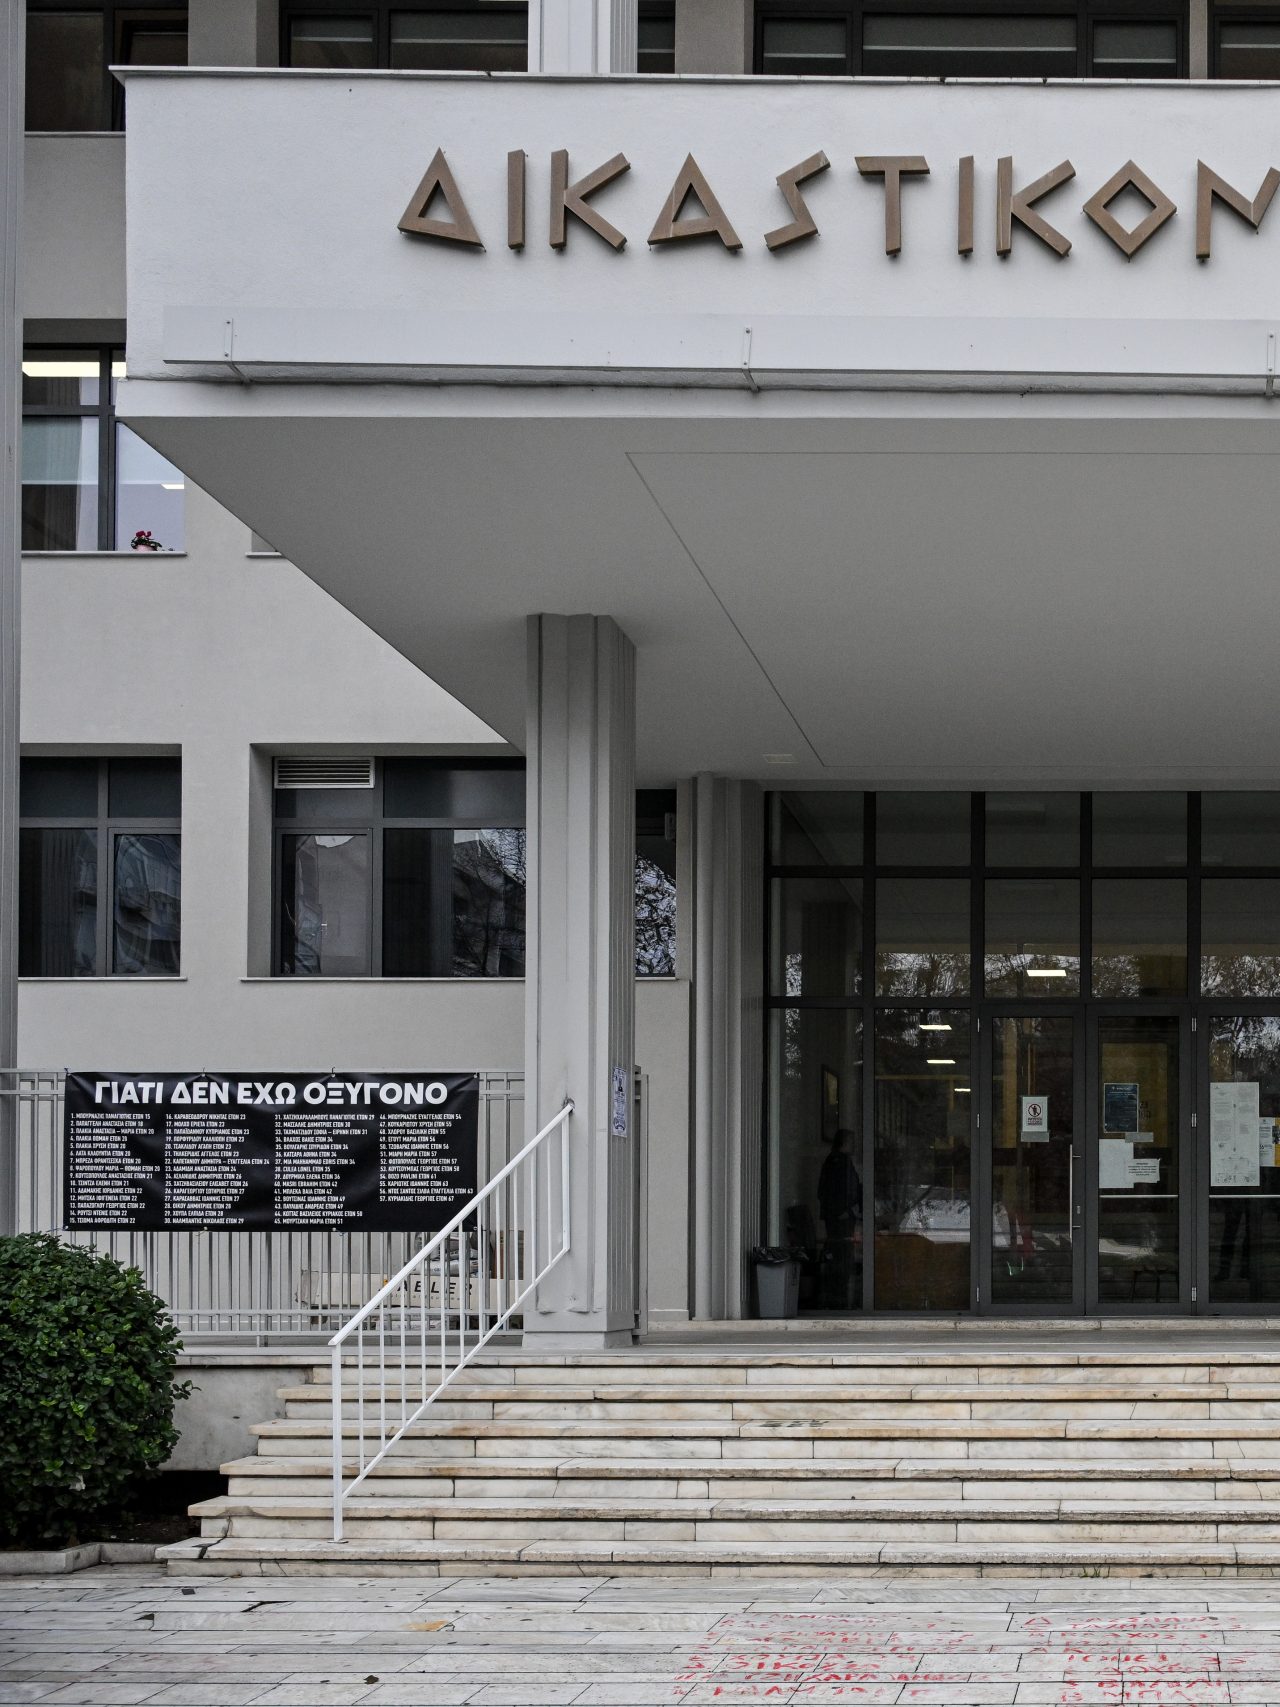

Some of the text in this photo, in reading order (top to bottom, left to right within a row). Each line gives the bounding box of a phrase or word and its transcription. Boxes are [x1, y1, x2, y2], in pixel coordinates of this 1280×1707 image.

[95, 1081, 448, 1105] ΓΙΑΤΙ ΔΕΝ ΕΧΩ ΟΞΥΓΟΝΟ
